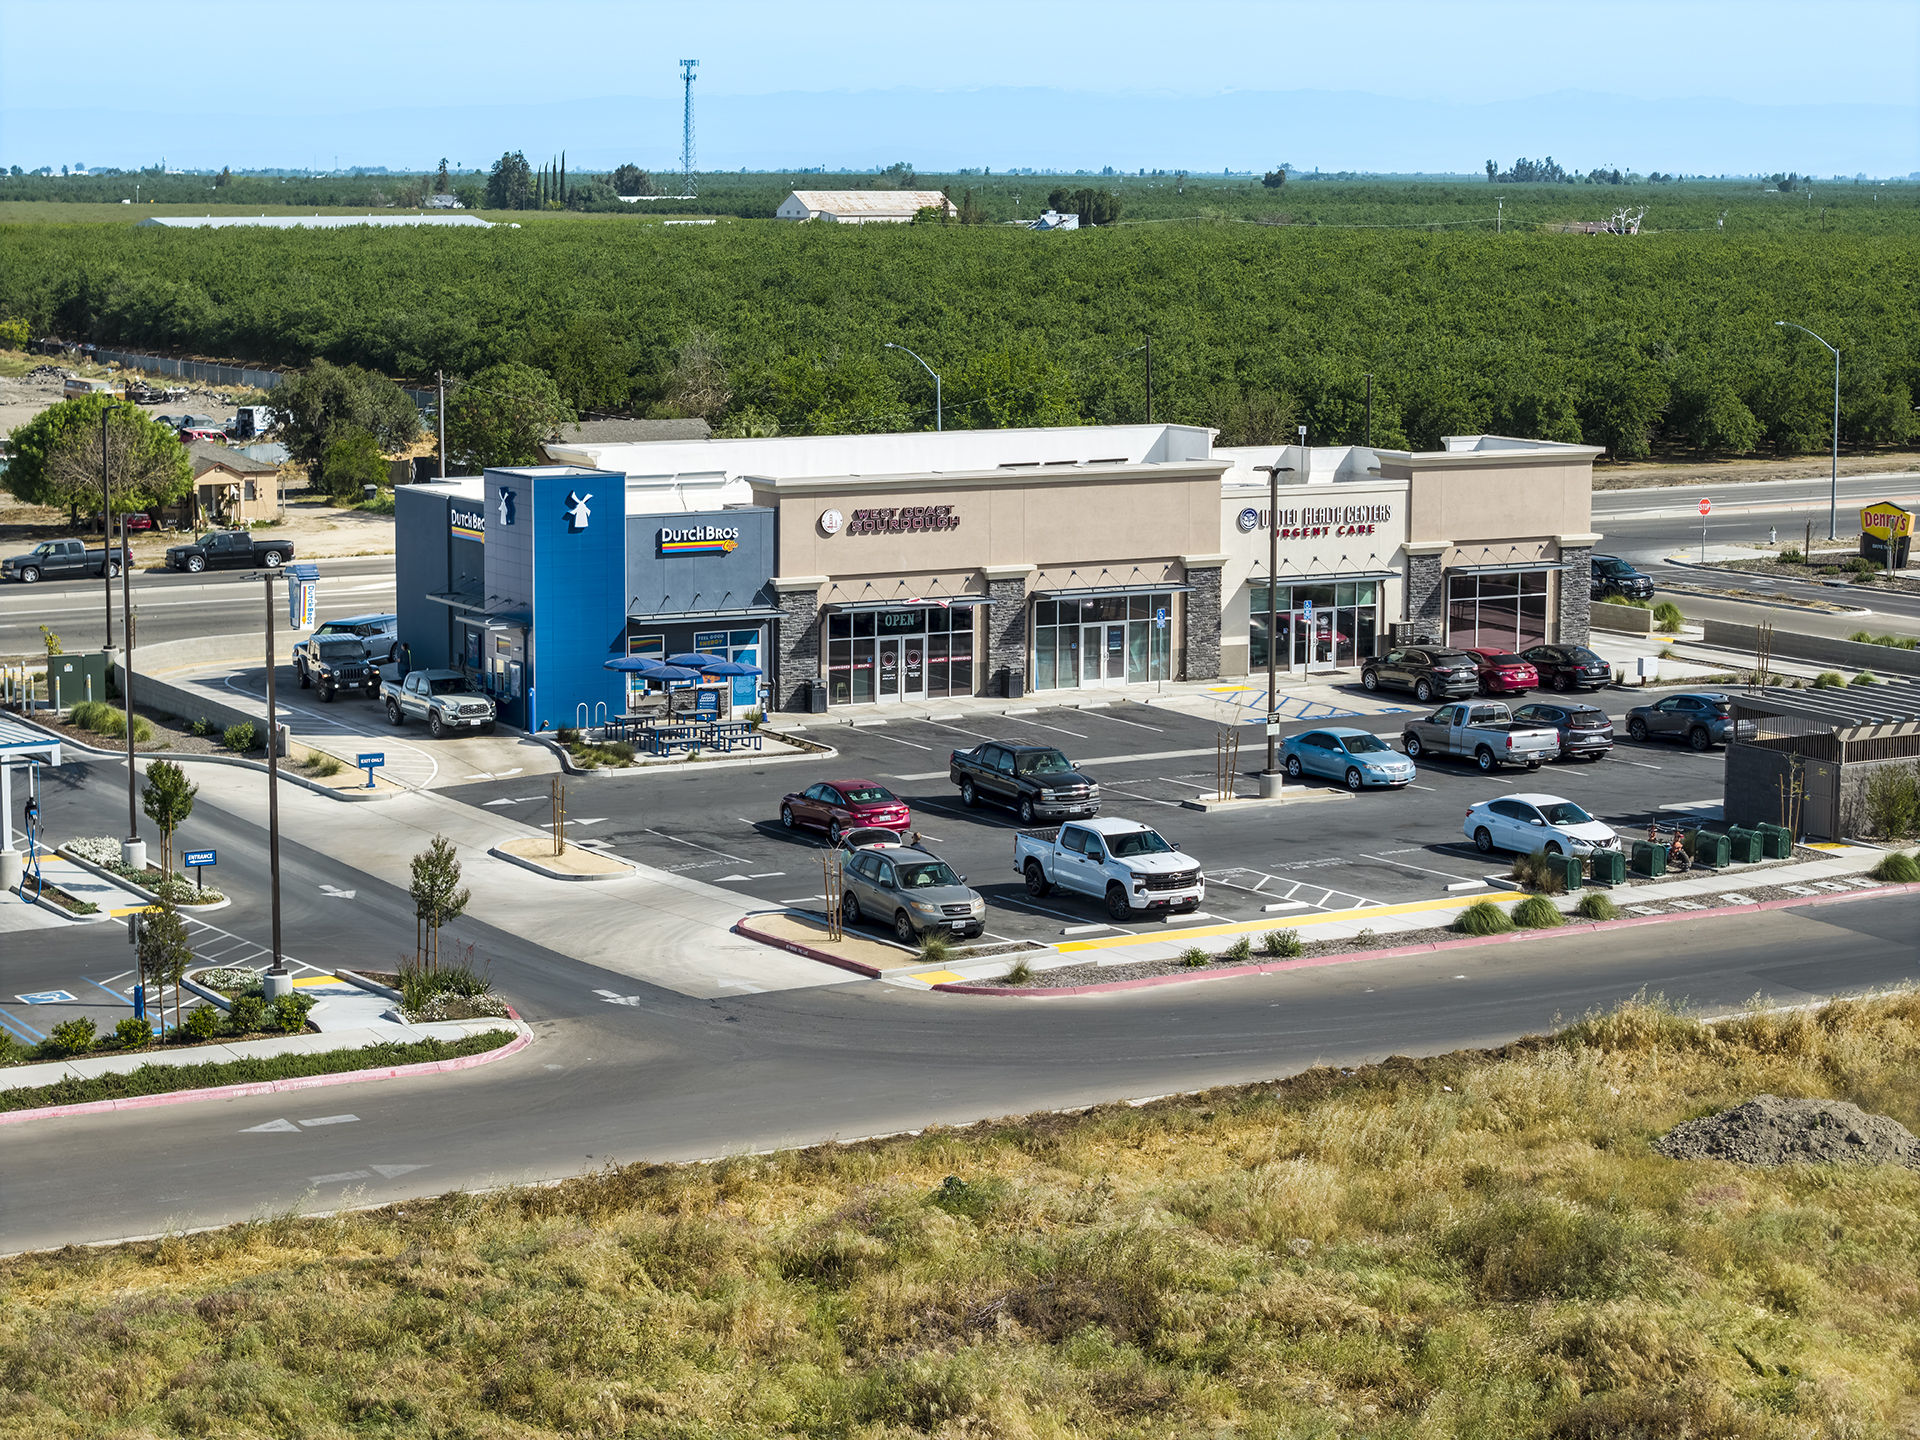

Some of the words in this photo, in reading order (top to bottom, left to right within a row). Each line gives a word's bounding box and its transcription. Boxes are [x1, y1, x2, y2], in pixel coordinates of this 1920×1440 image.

[857, 507, 900, 520] WEST
[903, 505, 955, 518] COAST
[1699, 503, 1710, 511] STOP
[451, 509, 473, 529] DUTCH
[851, 515, 960, 532] SOURDOUGH
[1261, 508, 1299, 527] UITED
[1304, 506, 1343, 525] HEALTH
[1346, 504, 1393, 522] CENTERS
[662, 526, 704, 542] DUTCH
[706, 525, 739, 540] BROS
[1337, 524, 1376, 536] CARE
[307, 585, 315, 607] DUTCH
[306, 607, 314, 625] BROS
[884, 613, 915, 627] OPEN
[188, 853, 214, 861] ENTRANCE
[251, 1086, 271, 1095] LANE
[294, 1079, 323, 1090] PARKING
